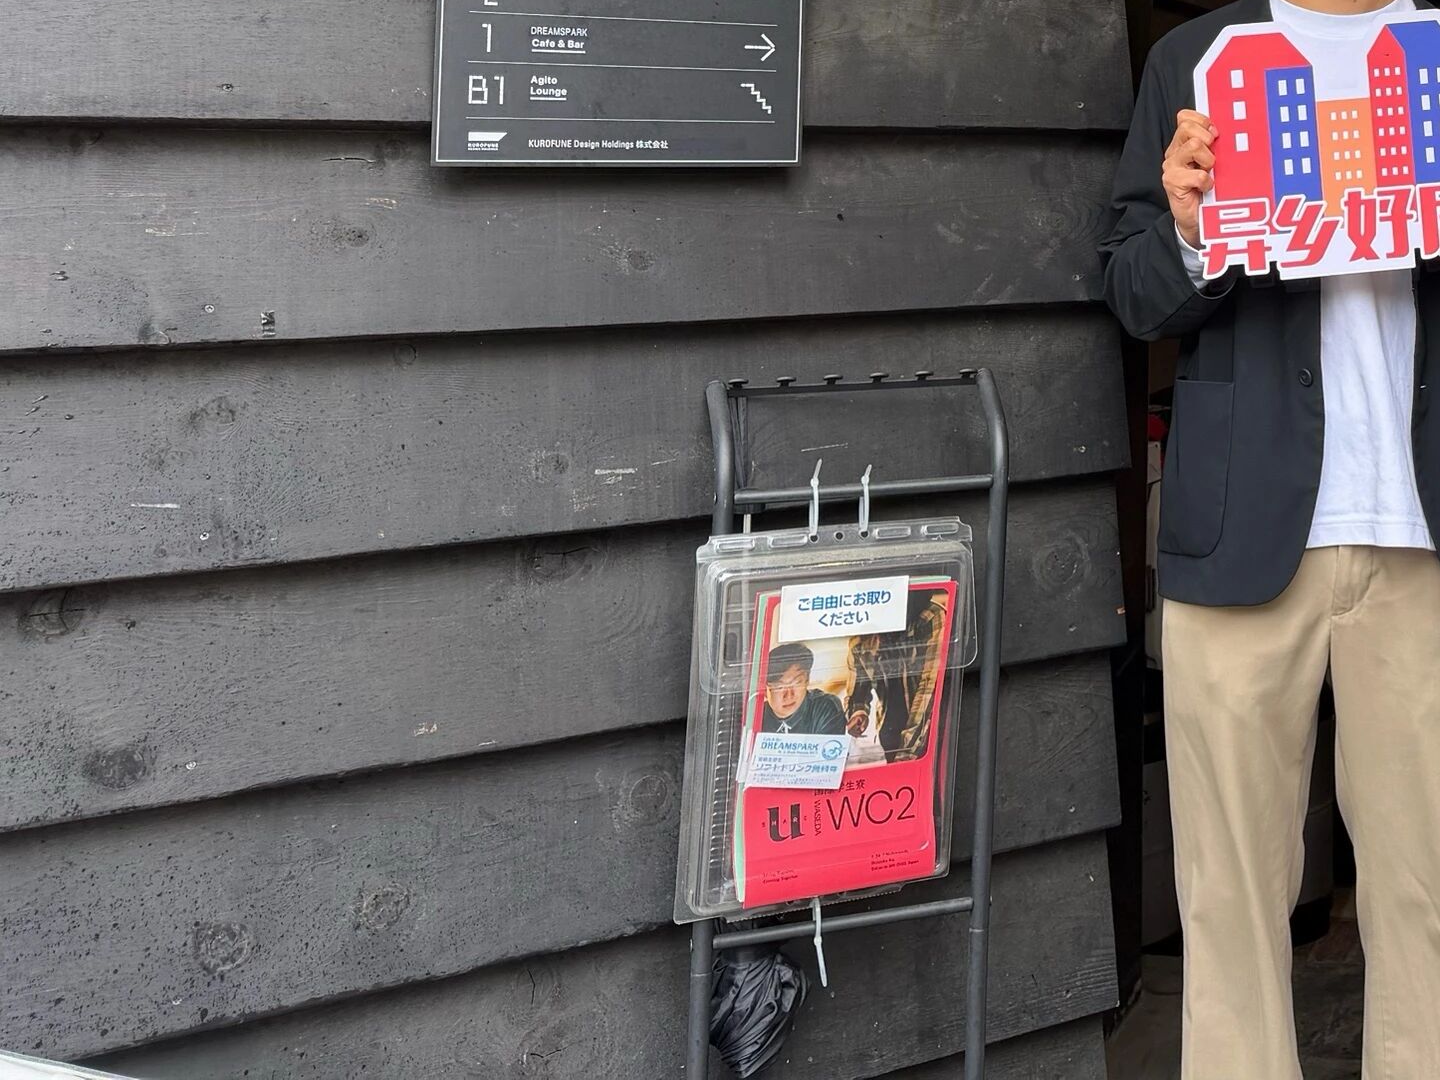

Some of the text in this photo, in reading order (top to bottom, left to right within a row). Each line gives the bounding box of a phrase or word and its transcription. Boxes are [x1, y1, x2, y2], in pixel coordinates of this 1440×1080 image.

[482, 24, 491, 52] 1
[531, 27, 588, 37] DREAMSPARK
[531, 39, 584, 49] Cafe & Bar
[530, 76, 558, 85] Agito
[468, 75, 504, 105] B1
[530, 87, 567, 97] Lounge
[528, 139, 572, 148] KUROFUNE
[574, 140, 600, 150] Design
[602, 140, 634, 150] Holdings
[798, 590, 892, 611] ご自由にお取り
[818, 611, 869, 627] ください
[761, 741, 819, 751] DREAMSPARK
[826, 786, 915, 831] WC2
[814, 799, 822, 837] WASEDA
